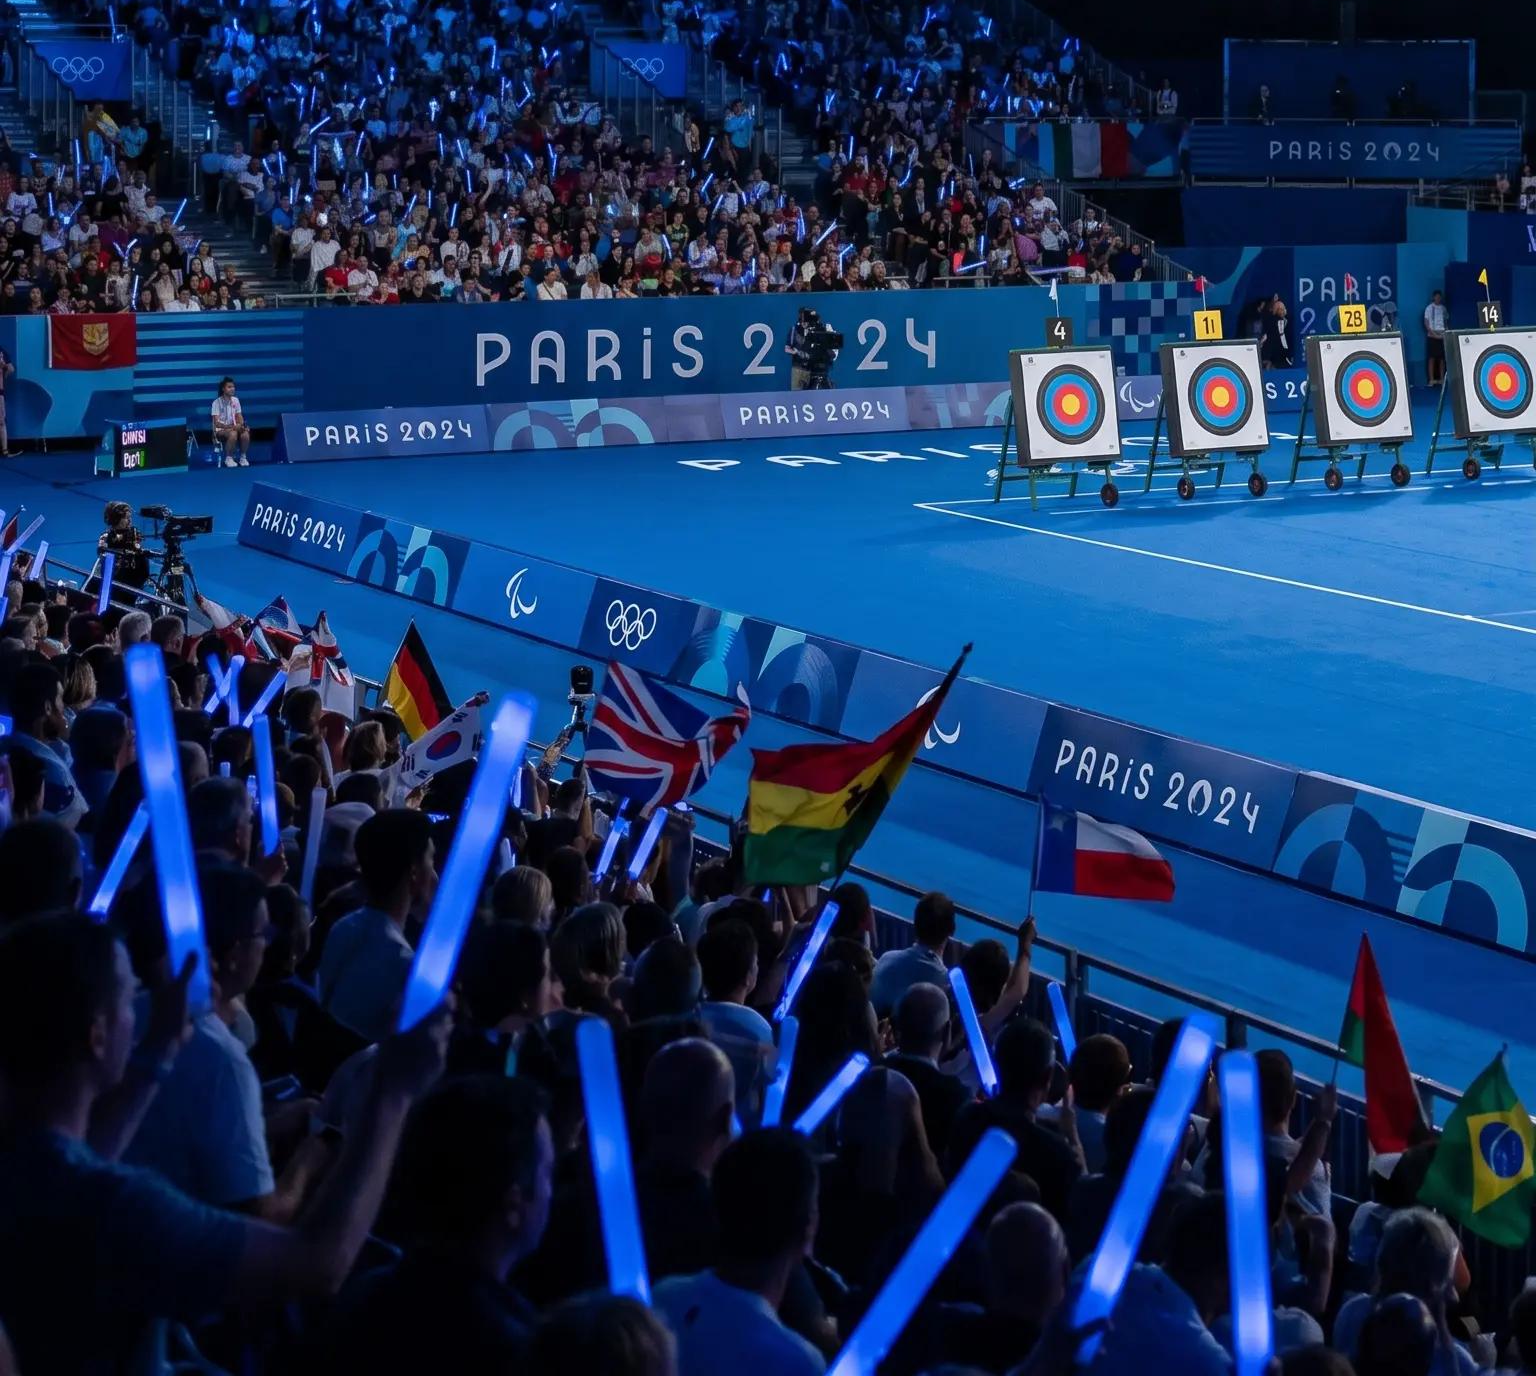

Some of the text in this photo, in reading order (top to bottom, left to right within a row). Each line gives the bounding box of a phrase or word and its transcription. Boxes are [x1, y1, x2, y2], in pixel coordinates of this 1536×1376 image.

[1364, 141, 1439, 162] 2024
[1482, 305, 1499, 323] 14
[1053, 321, 1066, 340] 4
[743, 318, 936, 375] 224
[825, 400, 890, 422] 2024
[400, 420, 472, 442] 2024
[301, 517, 346, 552] 2024
[1162, 771, 1260, 834] 2024
